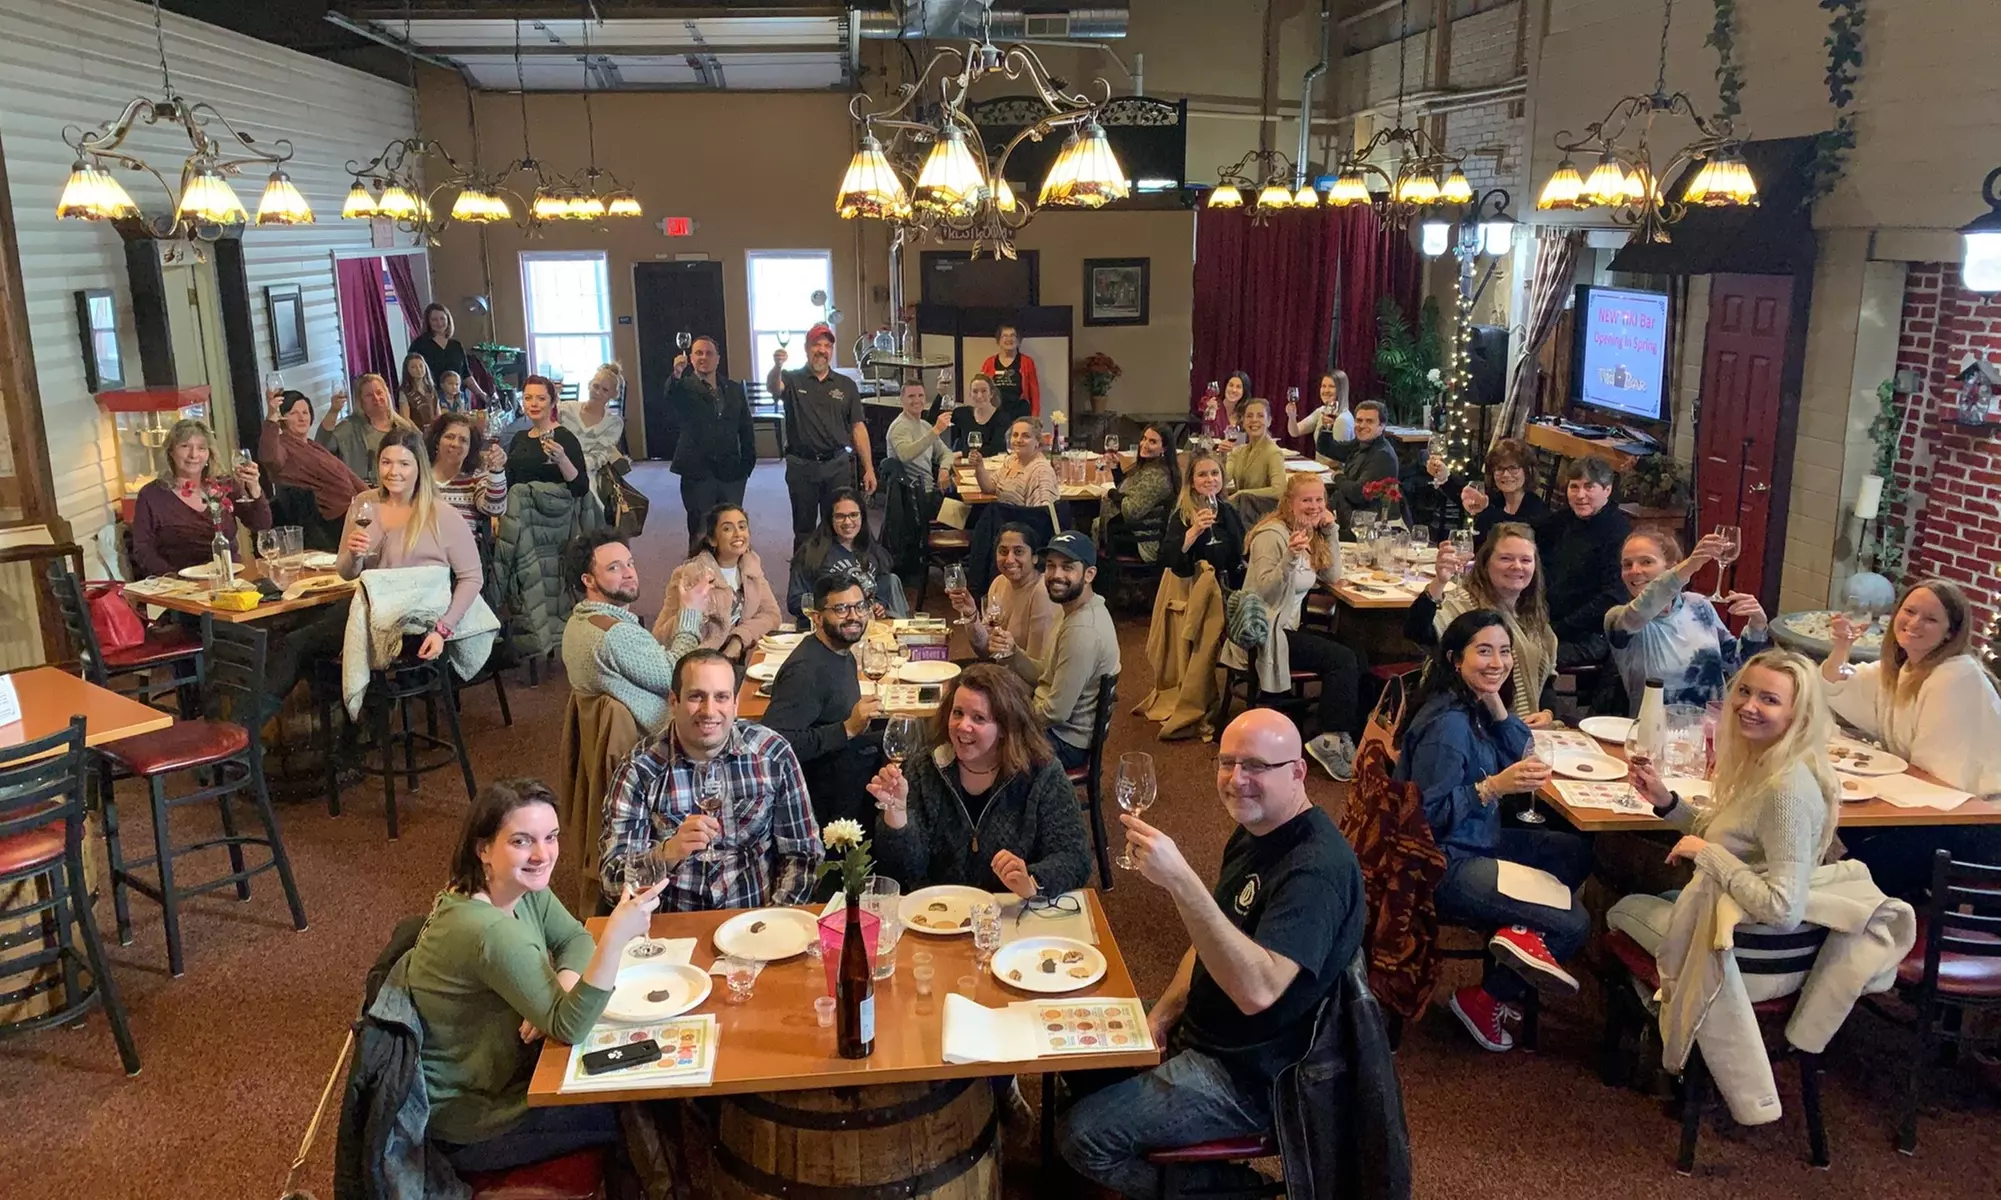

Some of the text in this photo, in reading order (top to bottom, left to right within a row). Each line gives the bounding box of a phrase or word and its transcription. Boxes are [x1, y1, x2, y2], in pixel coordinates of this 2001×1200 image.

[1598, 307, 1620, 325] NEW
[1640, 312, 1656, 329] Bar
[1594, 331, 1623, 350] Opening
[1633, 336, 1658, 356] Spring
